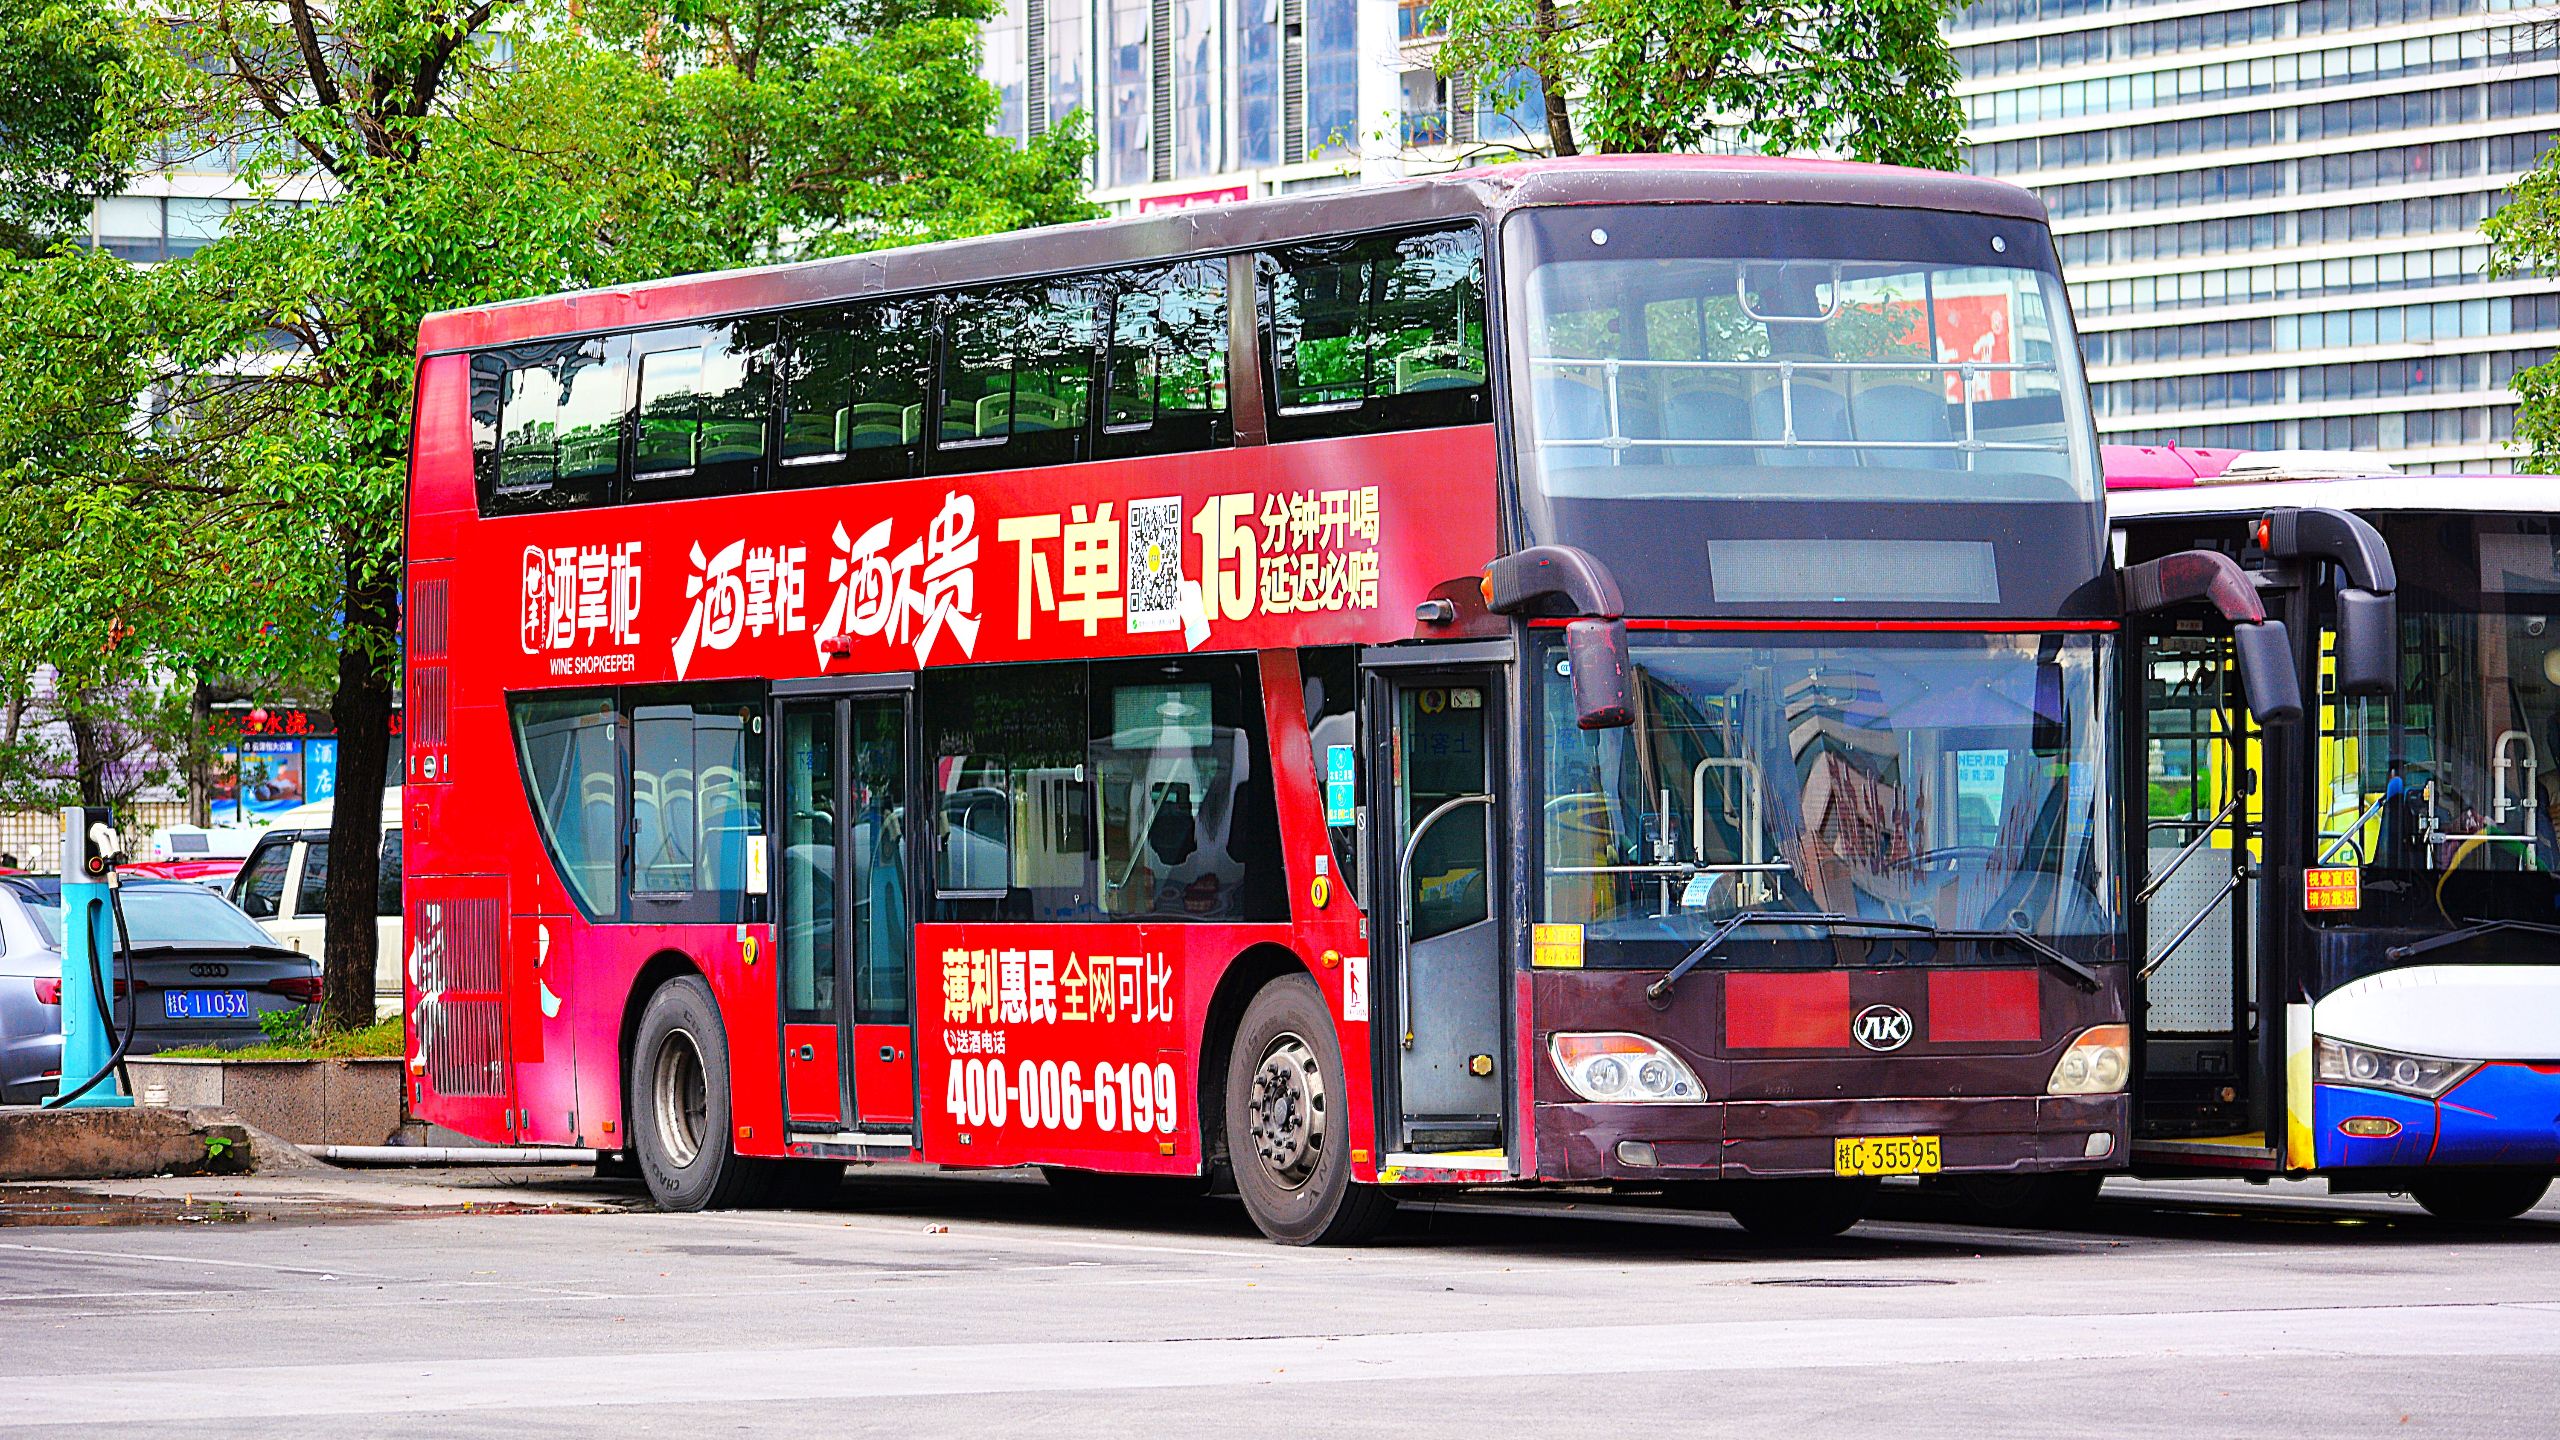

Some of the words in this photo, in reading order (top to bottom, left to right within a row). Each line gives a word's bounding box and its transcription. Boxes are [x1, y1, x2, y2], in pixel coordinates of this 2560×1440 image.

[1259, 485, 1380, 554] 分钟开喝
[545, 541, 642, 650] 酒掌柜
[672, 538, 806, 681] 酒掌柜
[813, 490, 982, 671] 酒不贵
[998, 502, 1123, 640] 下单
[1192, 493, 1258, 621] 15
[1259, 549, 1380, 616] 延迟必赔
[549, 658, 573, 676] WINE
[574, 653, 635, 675] SHOPKEEPER
[314, 742, 334, 795] 酒店
[2308, 870, 2355, 887] 视觉盲区
[2308, 890, 2355, 907] 请勿靠近
[942, 947, 1056, 1025] 薄利惠民
[1059, 951, 1174, 1024] 全网可比
[956, 1029, 1006, 1055] 送酒电话
[946, 1058, 1177, 1134] 400-006-6199
